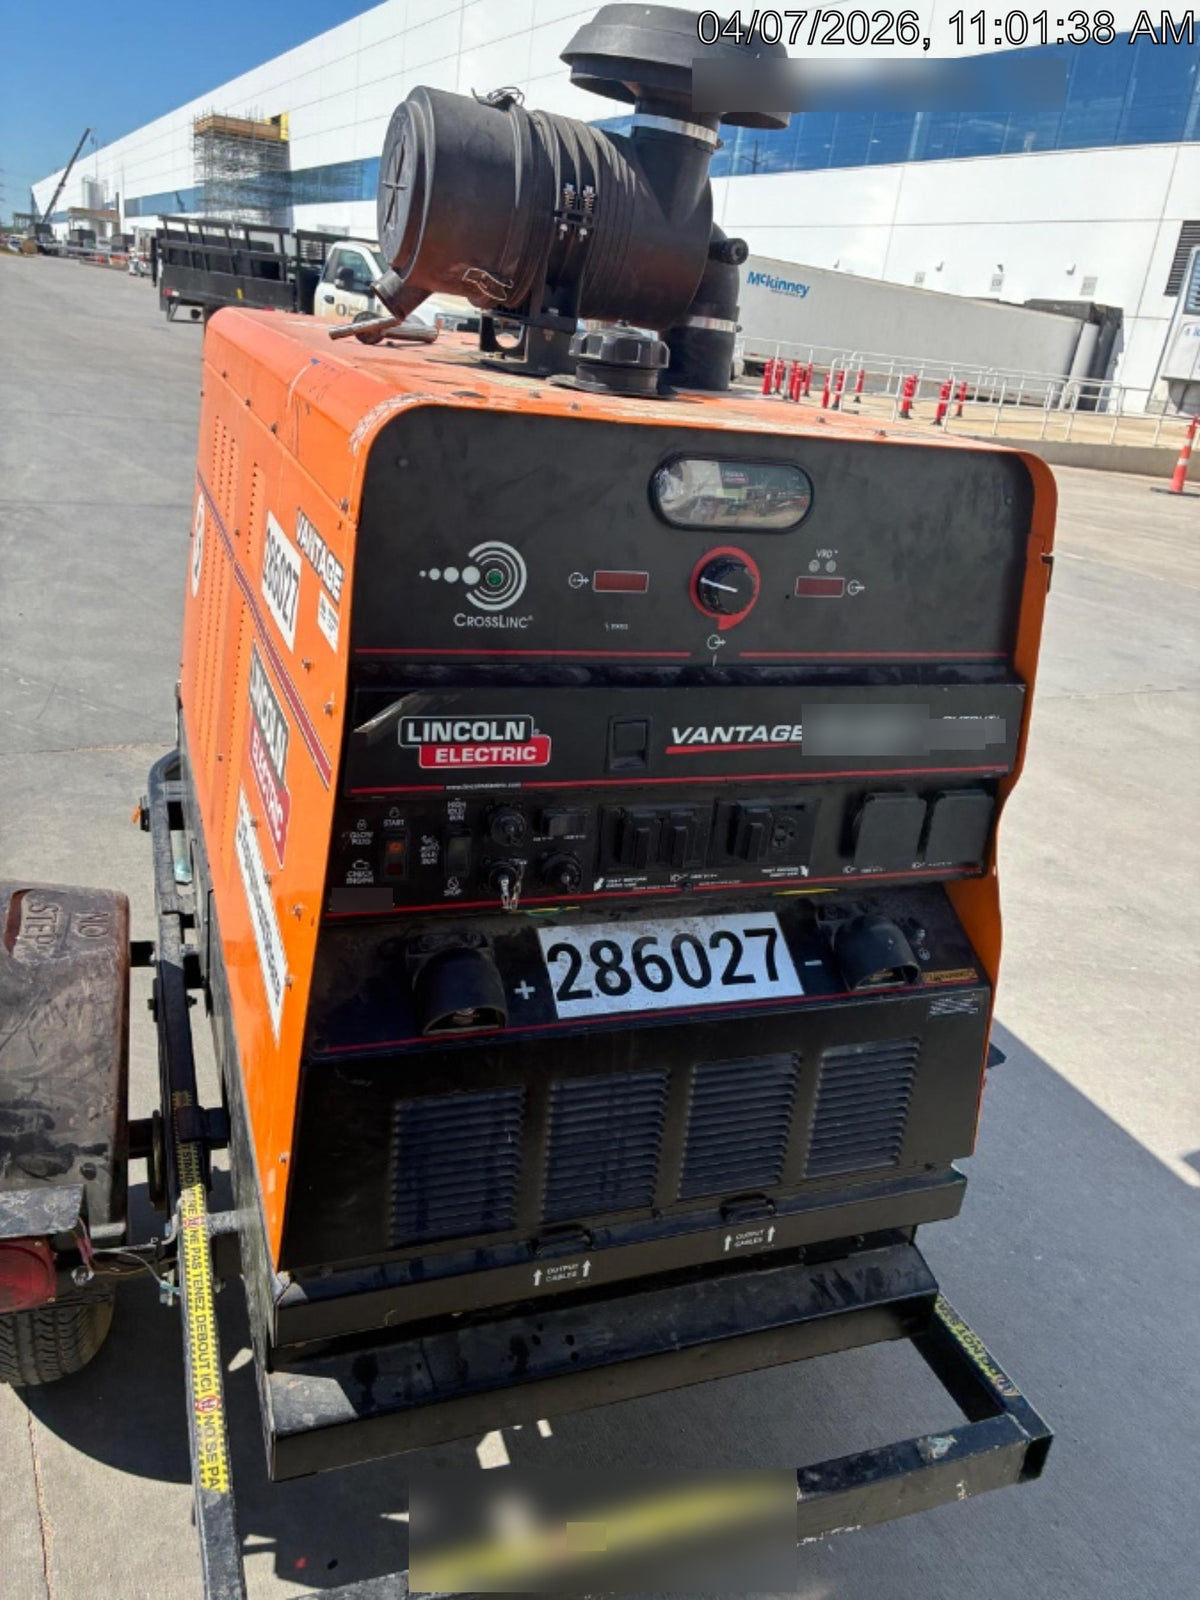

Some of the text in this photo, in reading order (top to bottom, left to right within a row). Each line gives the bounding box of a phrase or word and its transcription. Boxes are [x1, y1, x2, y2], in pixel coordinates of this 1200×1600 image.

[407, 721, 527, 742] LINCOLN
[670, 725, 802, 745] VANTAGE
[435, 746, 537, 764] ELECTRIC
[26, 902, 63, 949] STEP
[75, 910, 109, 940] NO
[547, 927, 780, 1002] 286027
[190, 1229, 200, 1244] NE
[190, 1246, 203, 1269] PAS
[192, 1273, 206, 1311] TENEZ
[195, 1316, 211, 1369] DEBOUT
[200, 1372, 213, 1393] ICI
[204, 1415, 216, 1436] NO
[205, 1438, 218, 1463] SE
